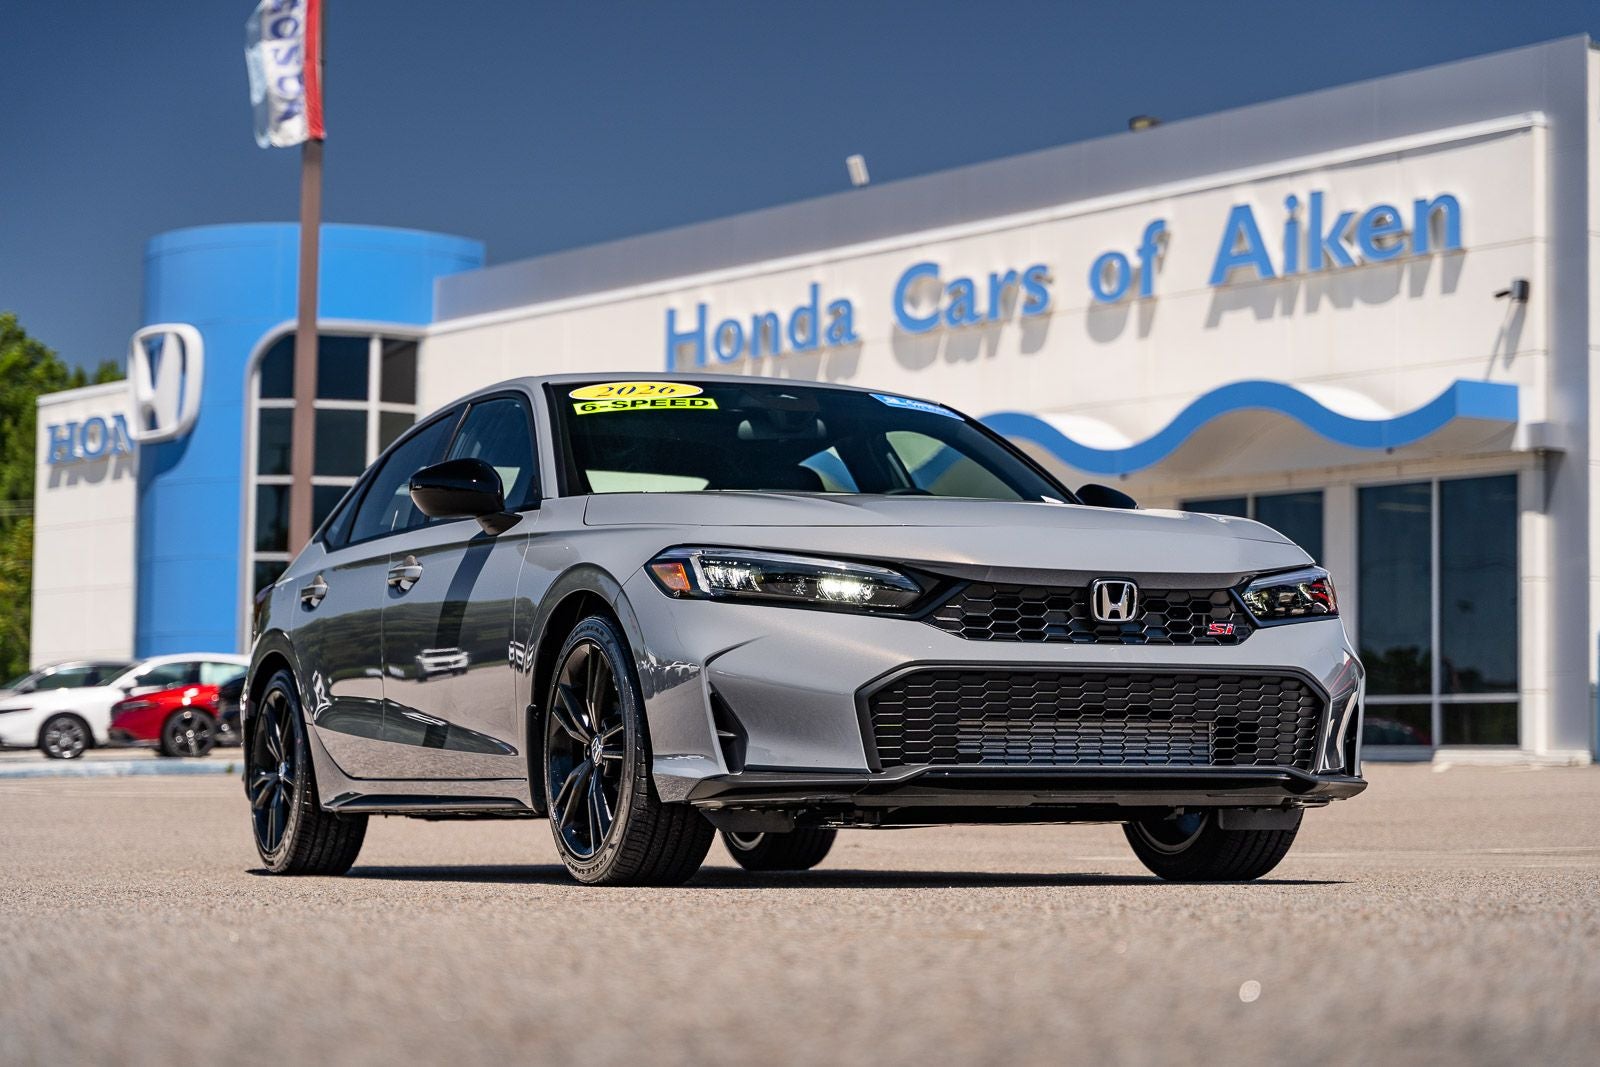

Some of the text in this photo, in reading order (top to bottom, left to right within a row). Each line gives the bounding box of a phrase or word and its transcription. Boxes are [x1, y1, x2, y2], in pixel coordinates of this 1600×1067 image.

[666, 191, 1462, 374] Honda Cars of Aiken
[596, 385, 676, 398] 2026
[580, 399, 709, 412] 6-SPEED
[1206, 623, 1234, 635] Si
